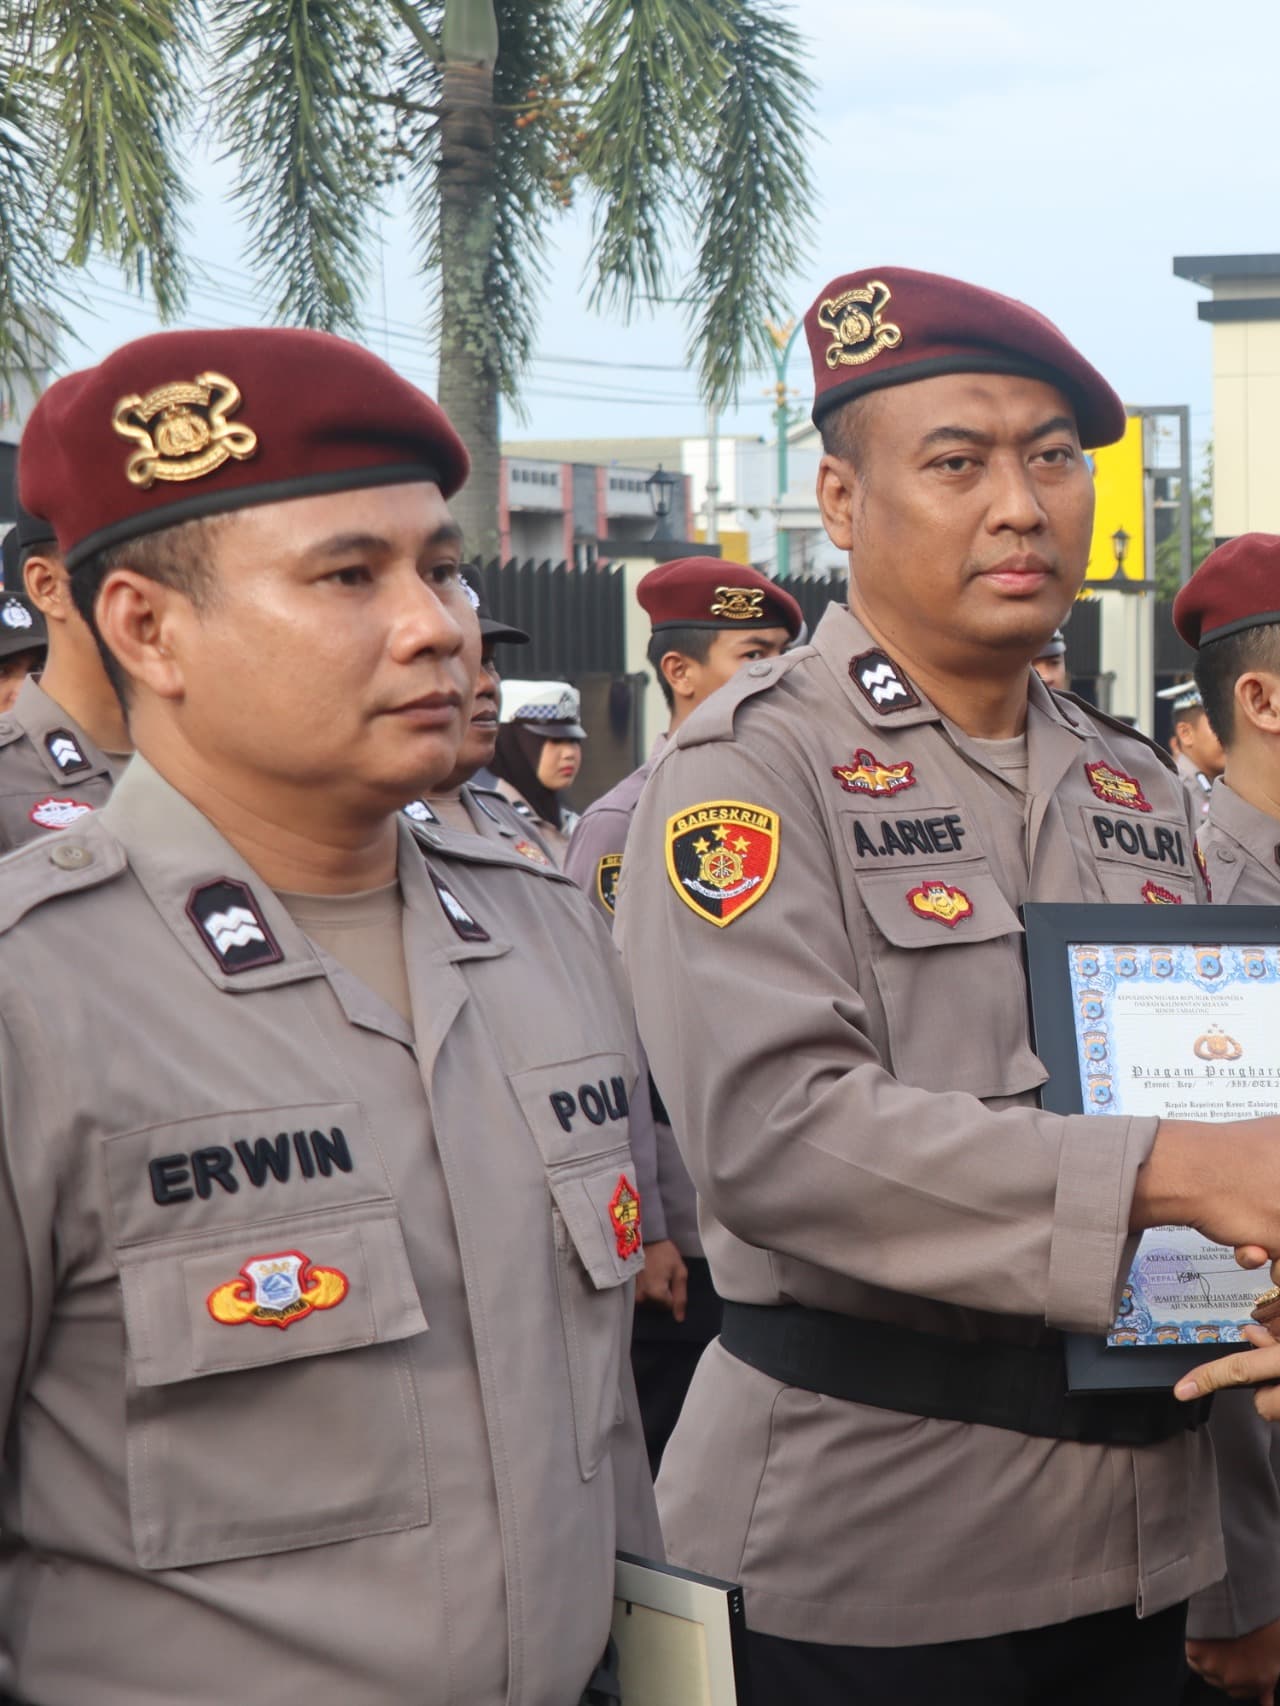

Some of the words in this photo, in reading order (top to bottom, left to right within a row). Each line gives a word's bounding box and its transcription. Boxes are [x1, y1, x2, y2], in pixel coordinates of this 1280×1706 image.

[676, 807, 769, 830] BARESKRIM
[853, 814, 965, 858] A.ARIEF
[1093, 815, 1185, 867] POLRI
[149, 1127, 353, 1206] ERWIN
